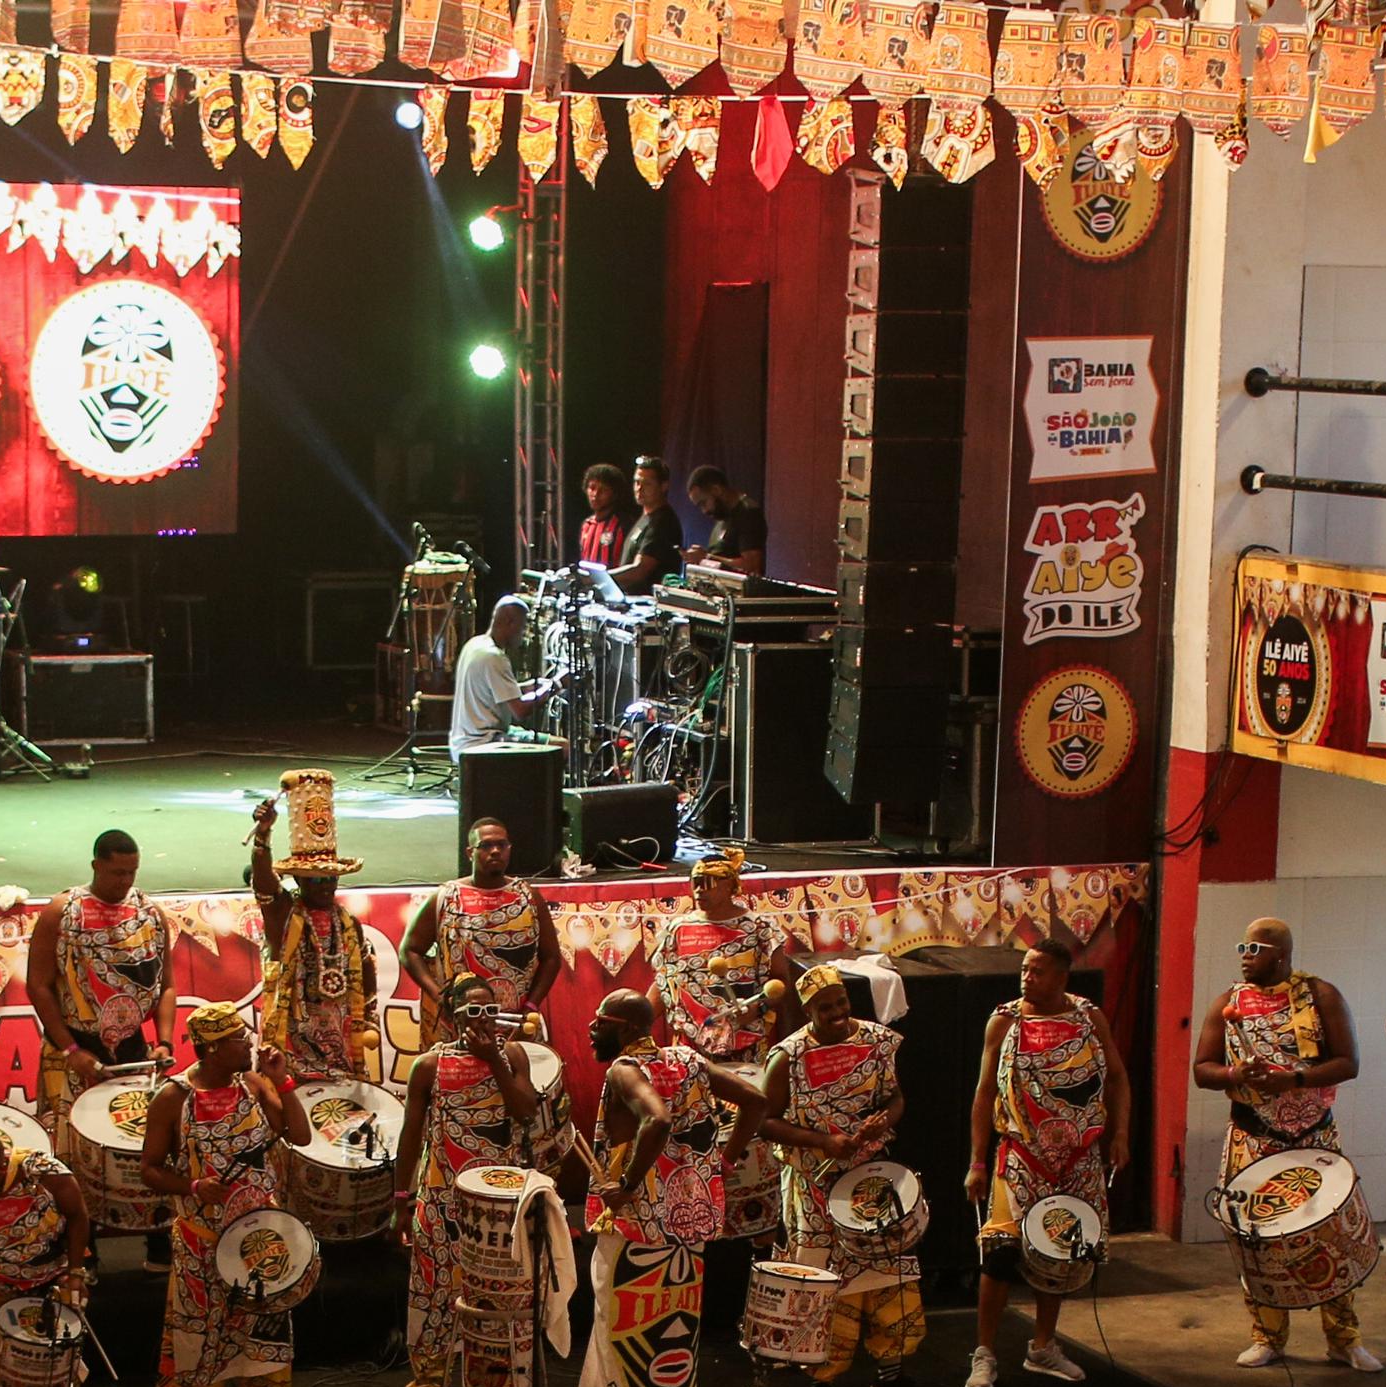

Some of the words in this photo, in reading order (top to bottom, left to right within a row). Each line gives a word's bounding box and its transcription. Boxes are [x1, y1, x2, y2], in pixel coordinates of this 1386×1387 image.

[1084, 364, 1135, 376] BAHIA
[1084, 379, 1106, 387] sem
[1108, 376, 1134, 388] fome
[1047, 411, 1088, 431] SÃO
[1060, 428, 1122, 448] BAHIA
[1042, 604, 1073, 628] DO
[1265, 638, 1281, 659] ILÊ
[1282, 642, 1309, 662] AIYÊ
[1263, 659, 1276, 676] 50
[1278, 663, 1310, 681] ANOS
